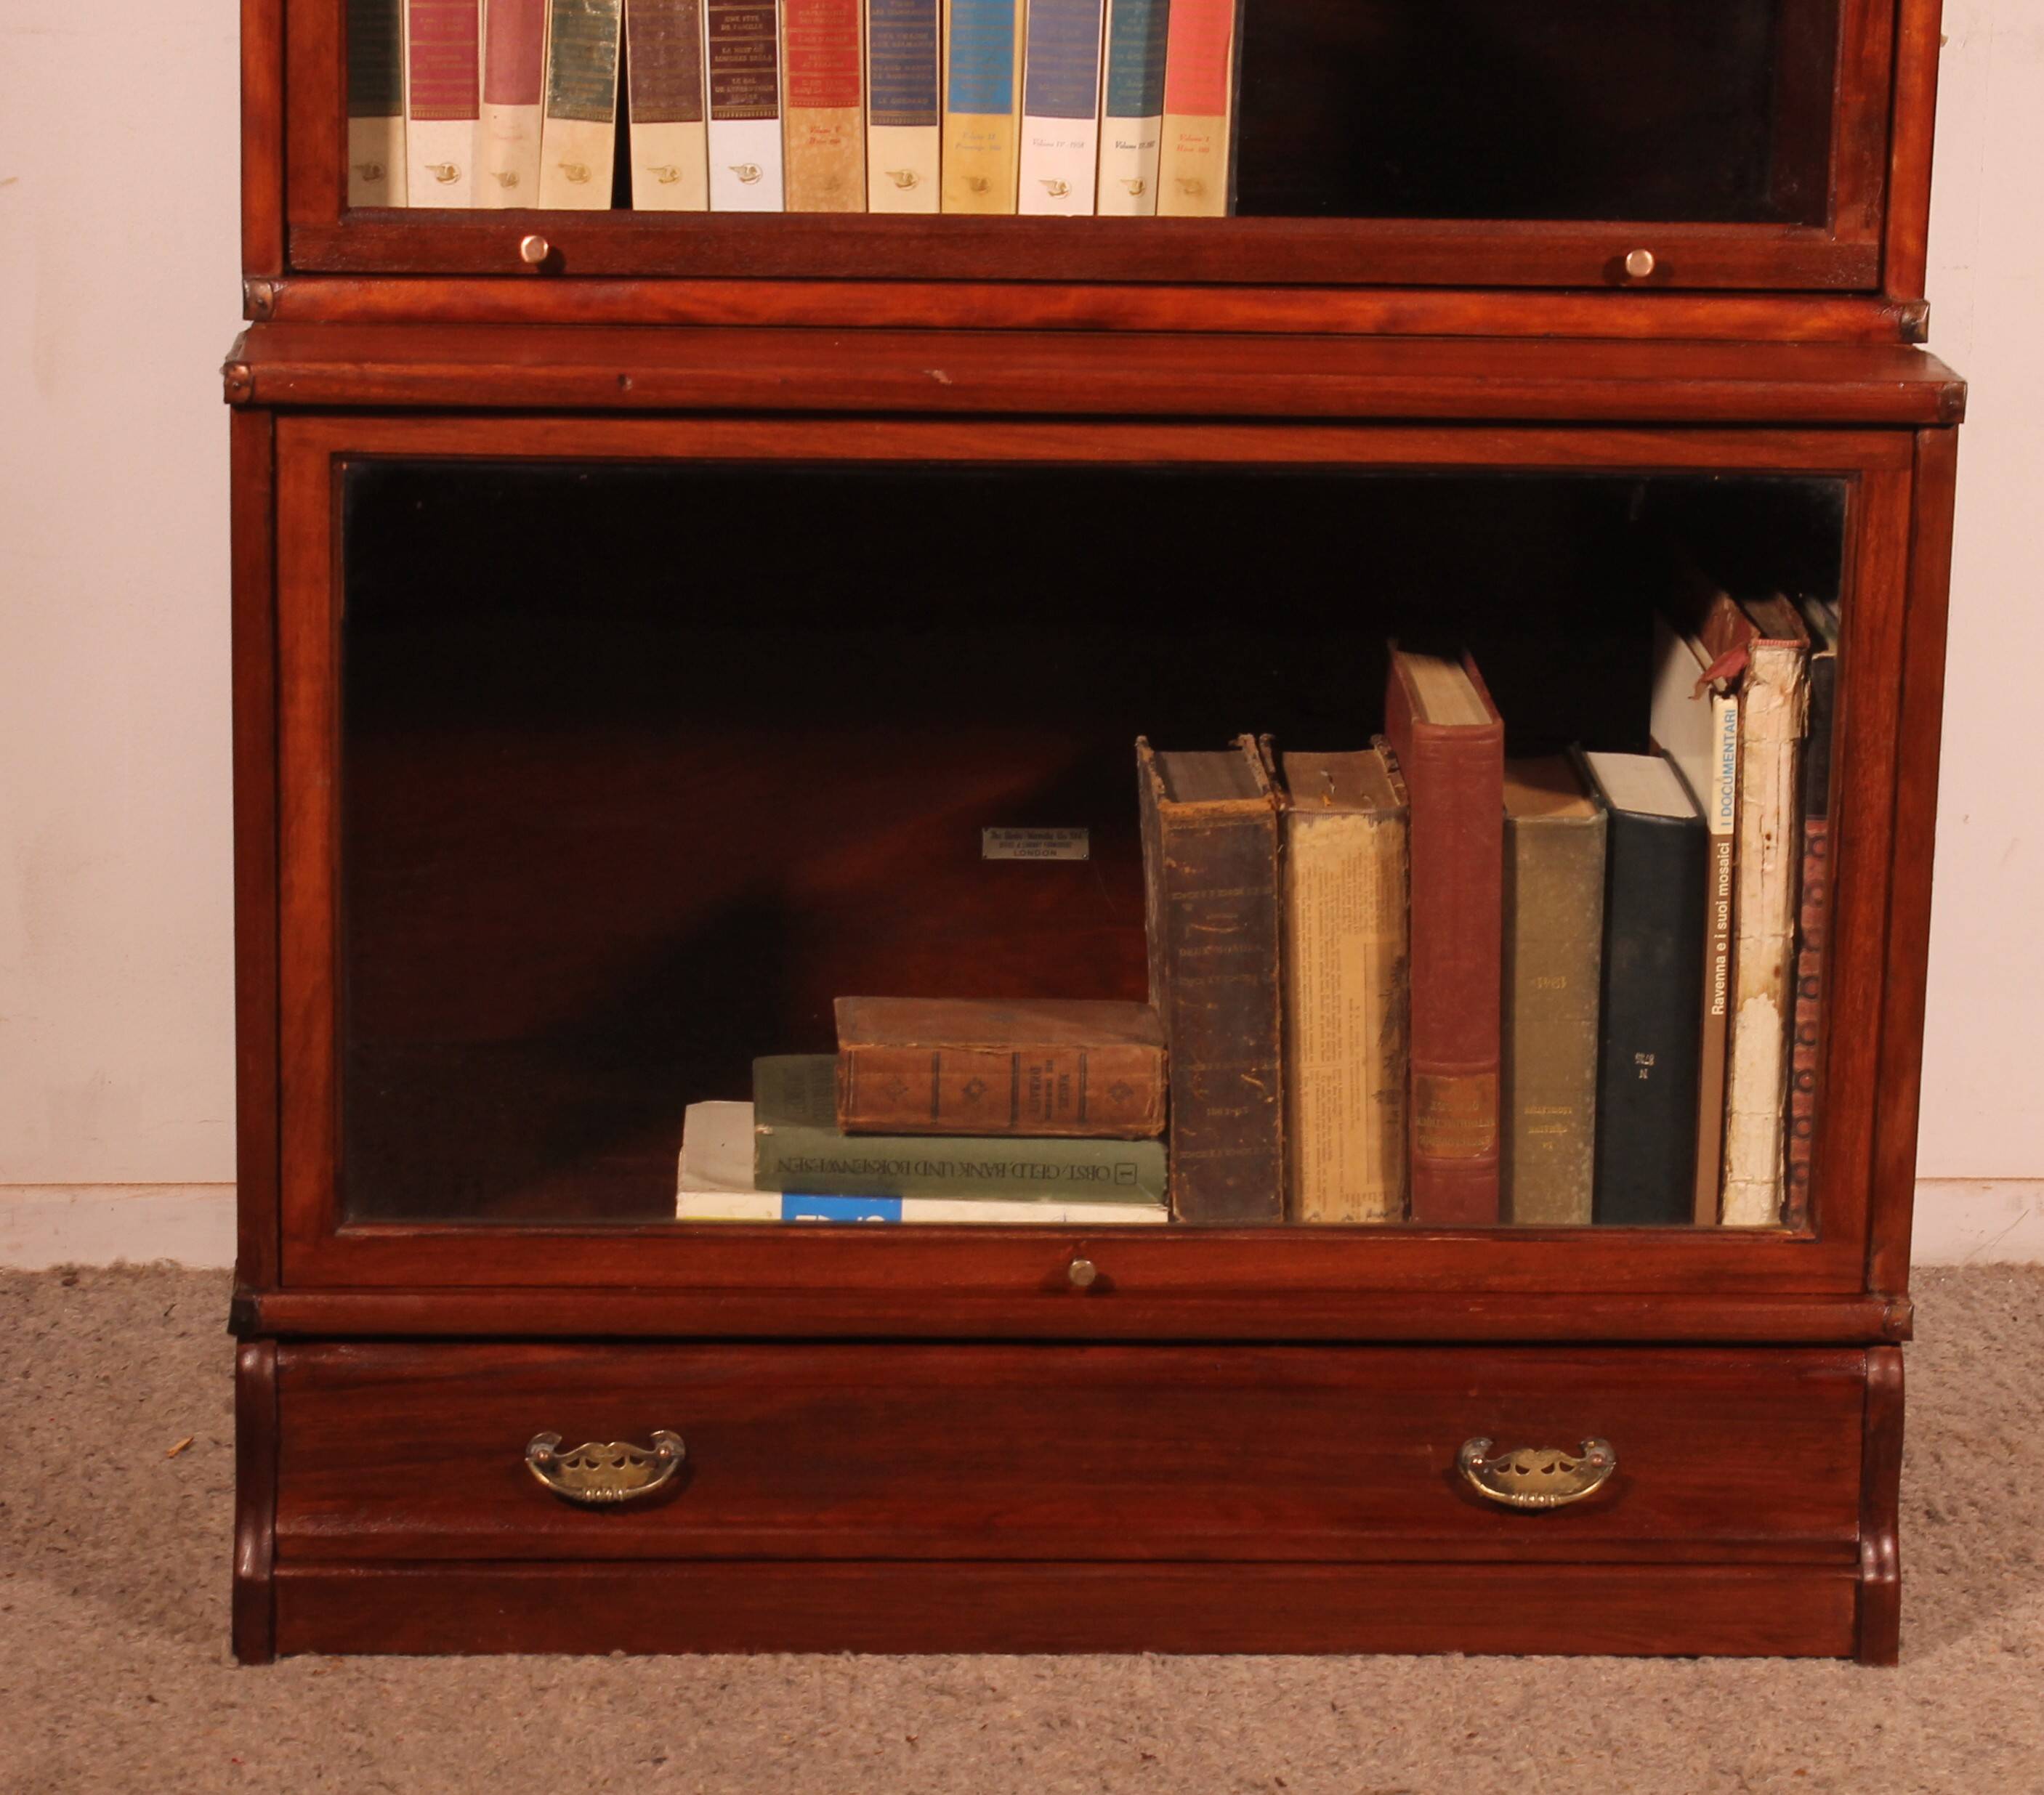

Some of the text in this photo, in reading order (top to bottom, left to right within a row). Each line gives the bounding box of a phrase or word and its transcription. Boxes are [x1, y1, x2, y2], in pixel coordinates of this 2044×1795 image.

[1721, 708, 1737, 818] DOCUMENTARI
[1718, 842, 1730, 896] mosaici
[1716, 901, 1728, 930] suoi
[1711, 955, 1726, 1015] Ravenna
[914, 1161, 955, 1178] UND
[958, 1162, 1006, 1179] BANK
